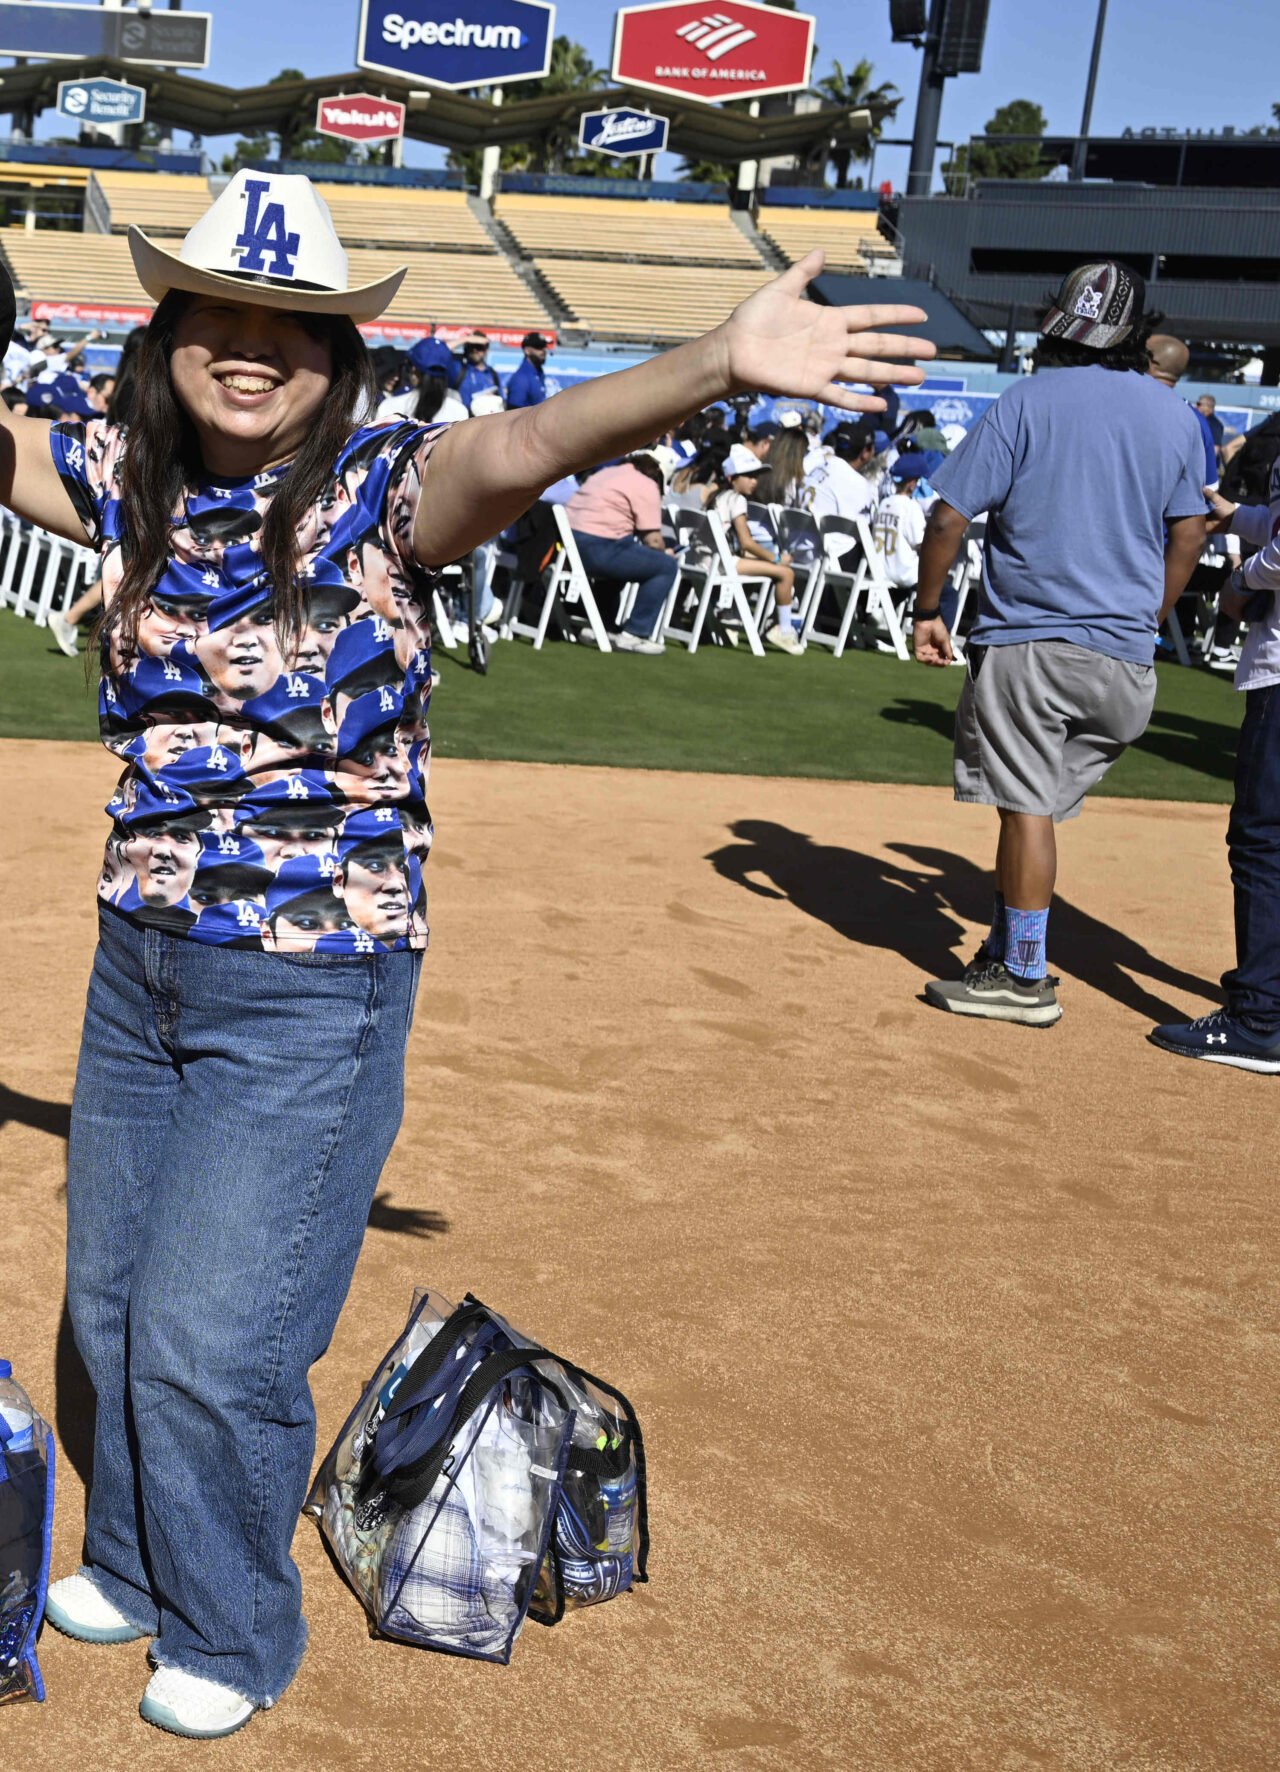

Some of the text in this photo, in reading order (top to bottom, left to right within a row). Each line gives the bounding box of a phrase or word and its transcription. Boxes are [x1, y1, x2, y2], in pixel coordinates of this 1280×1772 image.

[382, 13, 521, 50] Spectrum
[655, 66, 766, 81] BANK OF AMERICA
[90, 88, 137, 106] Security
[90, 102, 130, 117] Benefit
[322, 107, 399, 129] Yakult
[236, 179, 300, 277] LA
[66, 438, 84, 472] LA
[372, 613, 390, 642] LA
[161, 656, 182, 681] LA
[285, 673, 309, 697] LA
[379, 684, 394, 712] LA
[206, 745, 228, 771] LA
[286, 776, 309, 799] LA
[218, 831, 240, 855] LA
[235, 901, 260, 926] LA
[353, 928, 375, 953] LA
